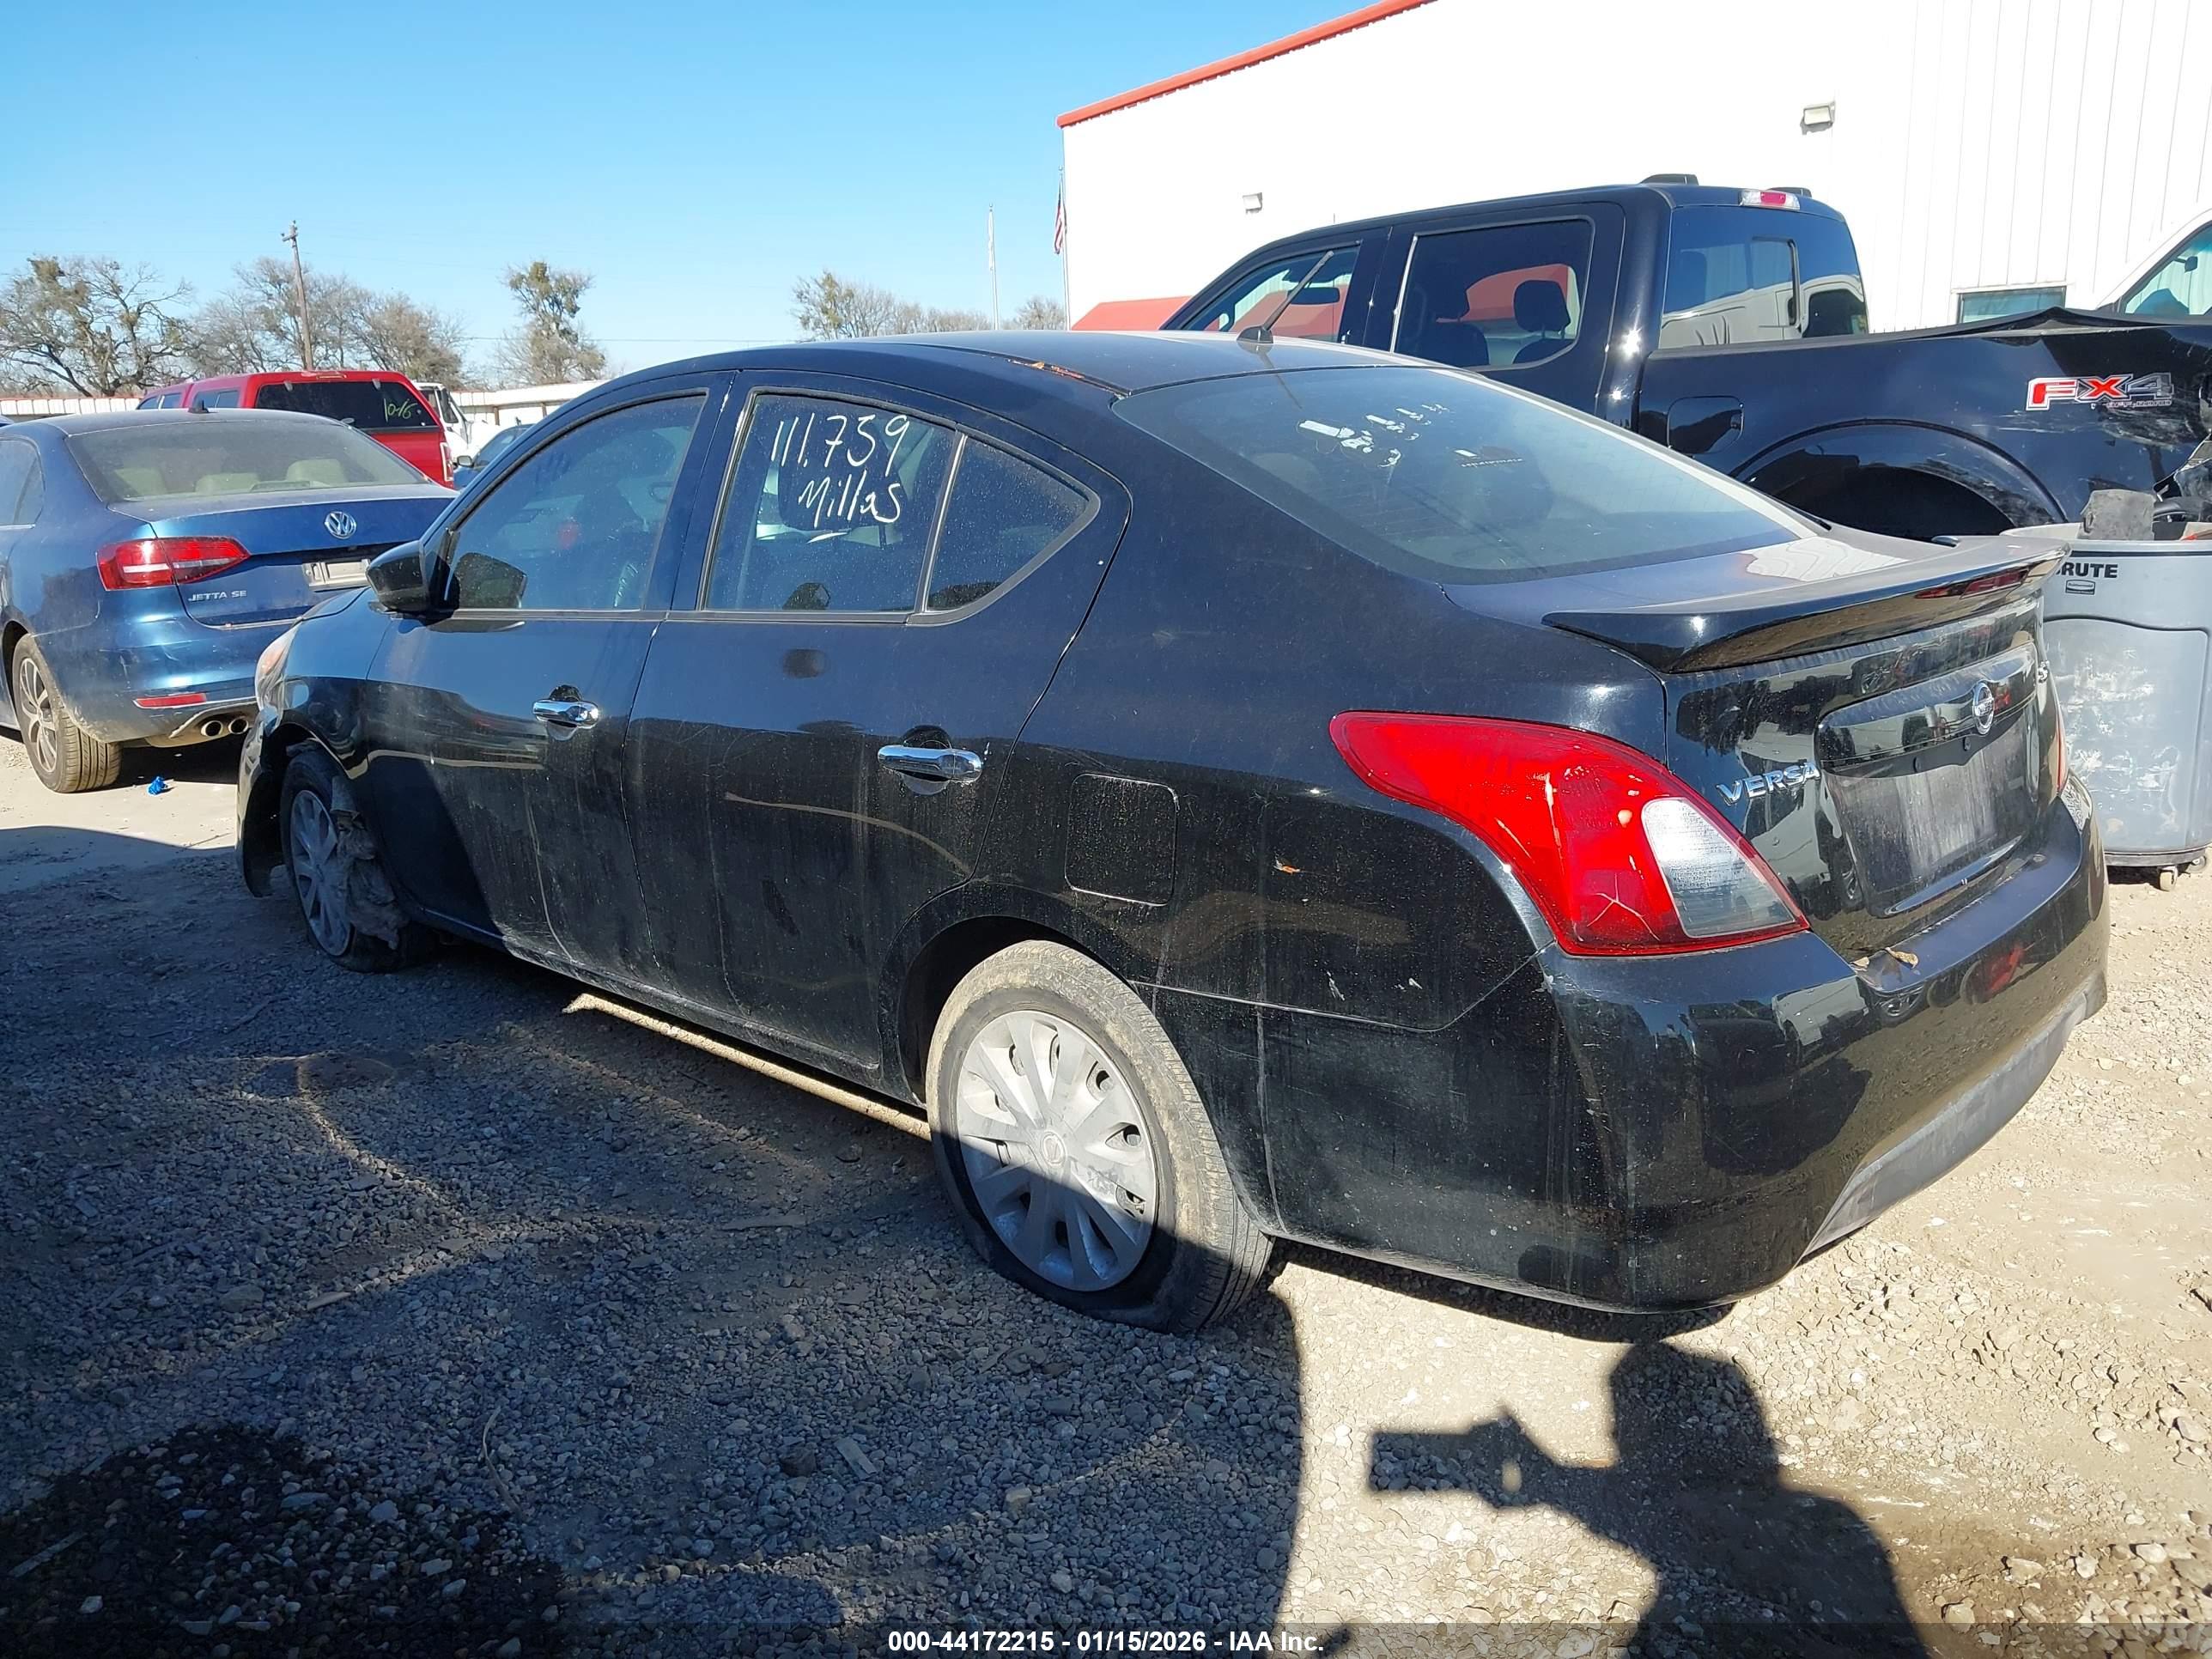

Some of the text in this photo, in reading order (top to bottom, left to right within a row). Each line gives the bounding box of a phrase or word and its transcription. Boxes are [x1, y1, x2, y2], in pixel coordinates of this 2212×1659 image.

[2026, 373, 2174, 410] FX4
[2056, 562, 2118, 579] RUTE
[188, 590, 247, 602] JETTA SE
[1716, 762, 1820, 806] VERSA
